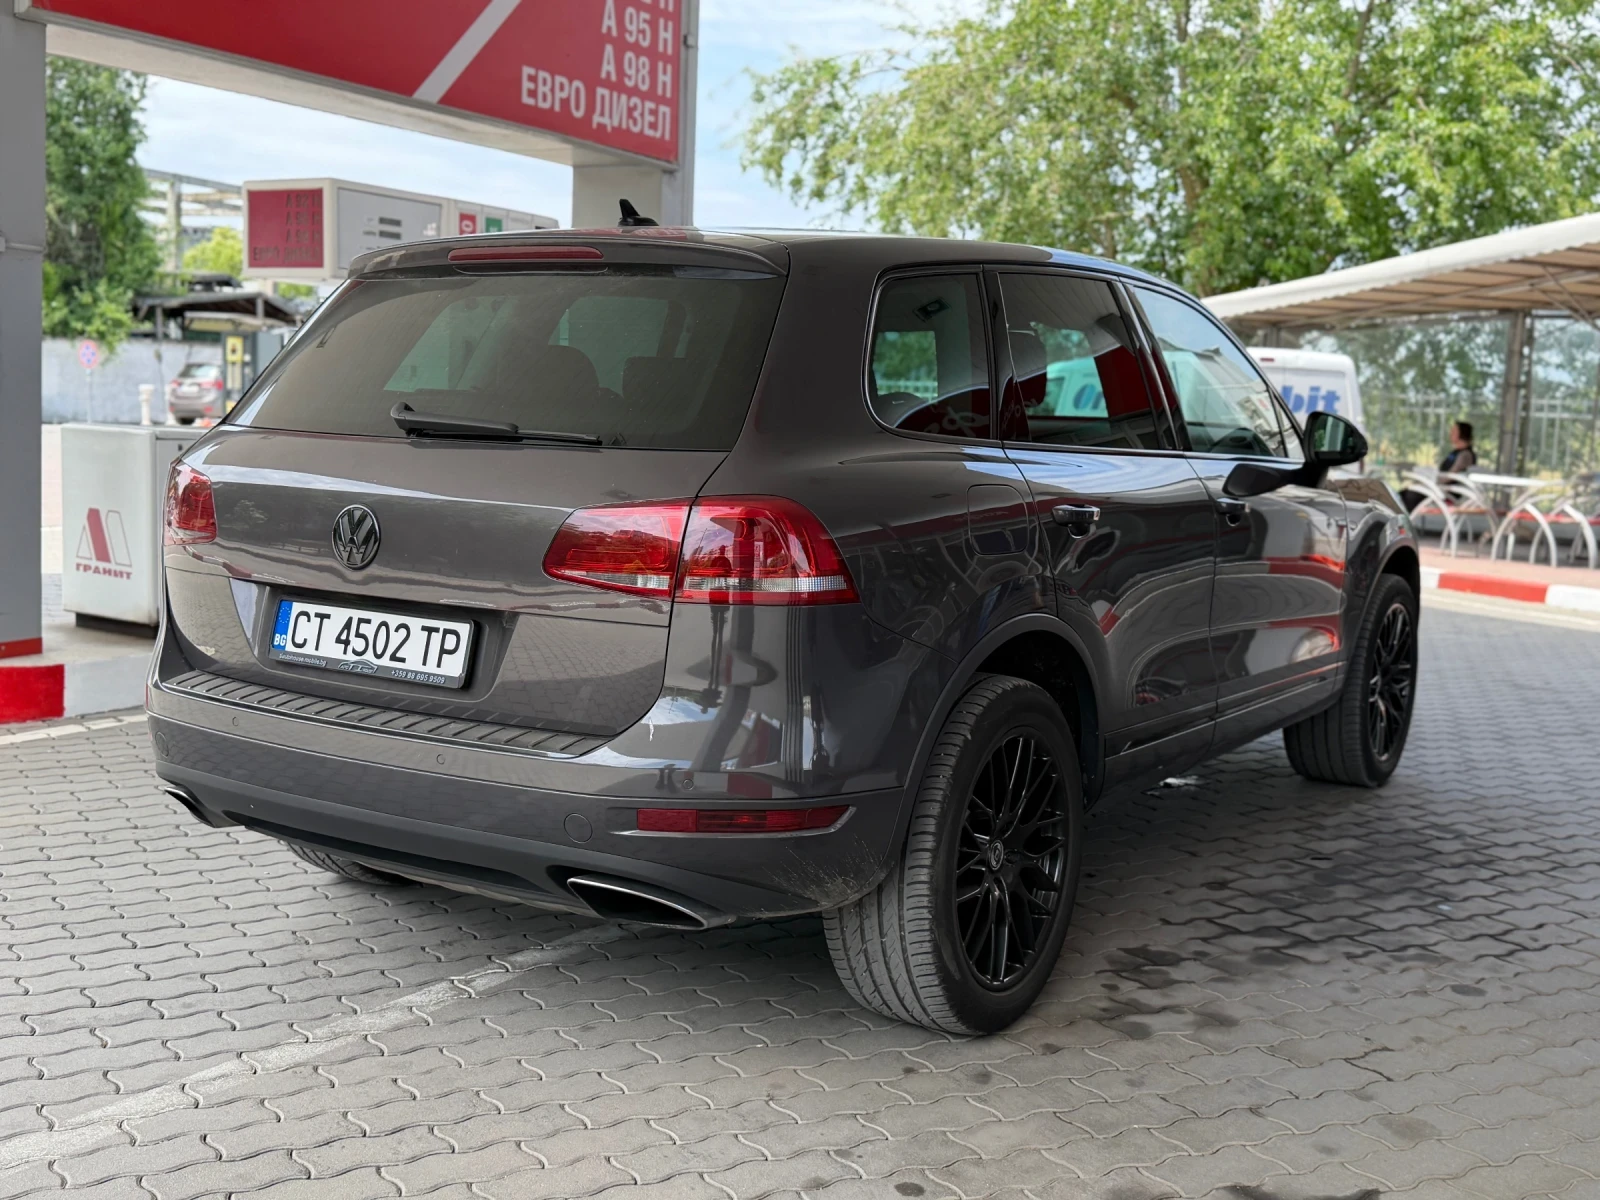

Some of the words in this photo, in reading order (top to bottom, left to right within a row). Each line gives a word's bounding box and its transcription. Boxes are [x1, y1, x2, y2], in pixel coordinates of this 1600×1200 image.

[625, 6, 651, 48] 95
[623, 51, 650, 91] 98
[521, 65, 586, 119] ЕВРО
[592, 86, 671, 141] ДИЗЕЛ
[75, 562, 133, 580] ГРАНИТ
[273, 633, 287, 646] BG
[291, 610, 331, 651] CT
[335, 616, 411, 664] 4502
[420, 625, 461, 669] TP
[391, 669, 406, 678] +359
